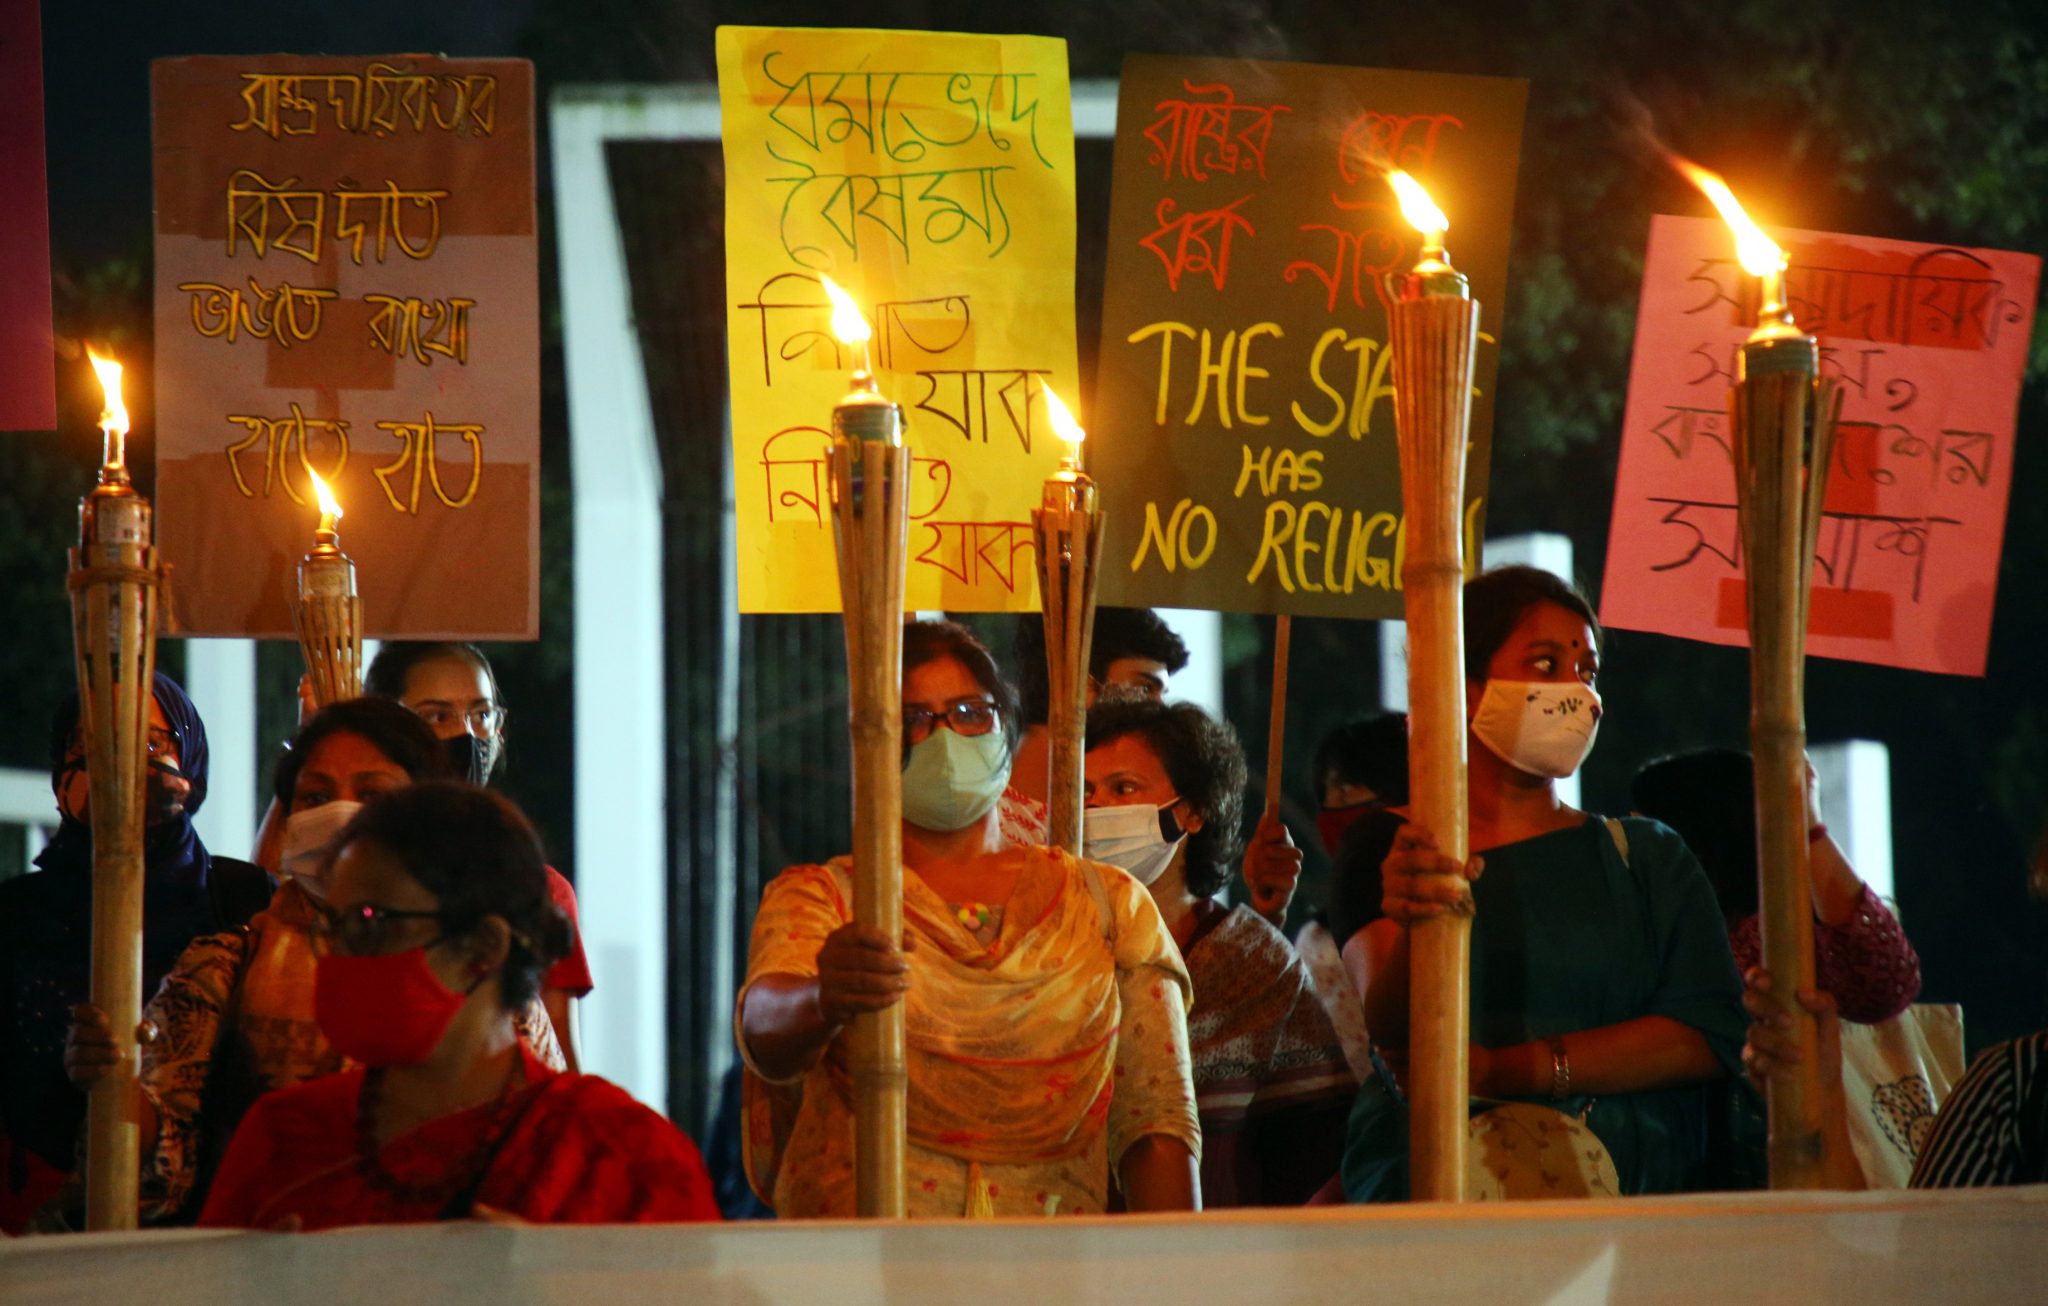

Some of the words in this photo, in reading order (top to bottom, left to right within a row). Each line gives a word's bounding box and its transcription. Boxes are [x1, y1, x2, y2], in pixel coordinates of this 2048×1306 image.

[1144, 79, 1293, 182] রাষ্ট্রের
[227, 170, 327, 263] বিষ
[765, 141, 1016, 270] বৈষম্য
[363, 294, 476, 366] রাখো
[737, 272, 970, 386] নিাত
[915, 368, 1053, 454] যাক
[1127, 321, 1284, 428] THE
[1291, 328, 1496, 440] STA
[226, 402, 351, 506] হাতে
[372, 410, 486, 516] হাত
[1234, 444, 1325, 498] HAS
[915, 520, 1037, 593] যাক
[1130, 497, 1218, 572] NO
